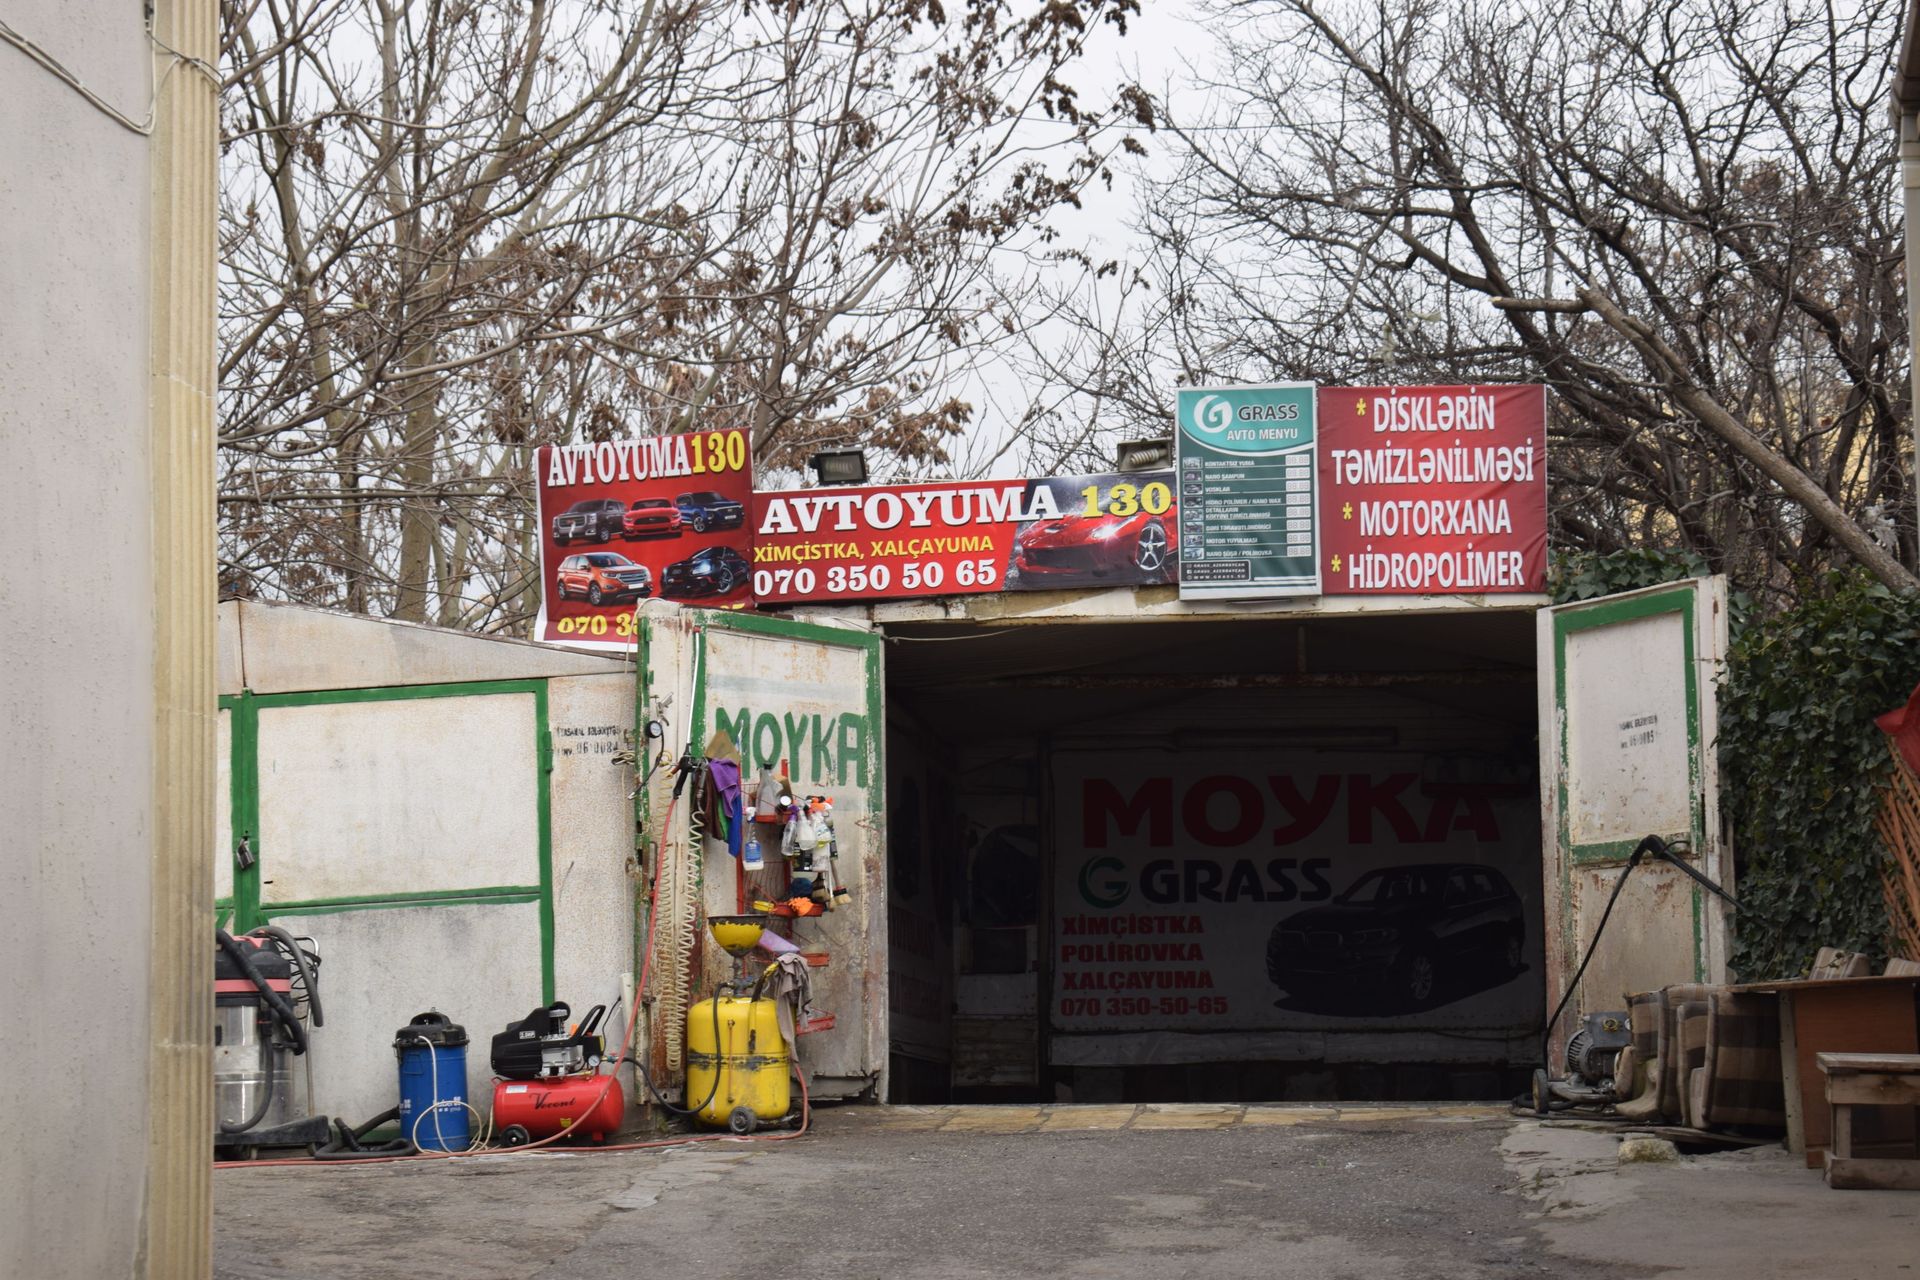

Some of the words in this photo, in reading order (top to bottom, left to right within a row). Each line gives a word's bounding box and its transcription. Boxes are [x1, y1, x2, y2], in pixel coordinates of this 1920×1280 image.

[1237, 404, 1299, 421] GRASS
[1373, 386, 1495, 432] DİSKLƏRİN
[1227, 429, 1256, 441] AVTO
[1259, 428, 1298, 440] MENYU
[547, 435, 691, 487] AVTOYUMA
[691, 430, 746, 474] 130
[1331, 437, 1534, 485] TƏMİZLƏNİLMƏSİ
[757, 485, 1064, 534] AVTOYUMA
[1080, 481, 1172, 517] 130
[1360, 499, 1513, 536] MOTORXANA
[753, 541, 865, 565] XİMÇİSTKA,
[870, 536, 994, 559] XALÇAYUMA
[1348, 542, 1526, 589] HİDROPOLİMER
[753, 567, 816, 596] 070
[826, 564, 891, 593] 350
[902, 560, 945, 588] 50
[954, 558, 997, 586] 65
[557, 614, 608, 635] 070
[715, 707, 868, 789] MOYKA
[1138, 857, 1333, 905] GRASS
[1061, 914, 1205, 937] XİMÇİSTKA
[1061, 943, 1204, 964] POLİROVKA
[1062, 970, 1215, 993] XALÇAYUMA
[1061, 998, 1101, 1017] 070
[1105, 996, 1229, 1016] 350-50-65
